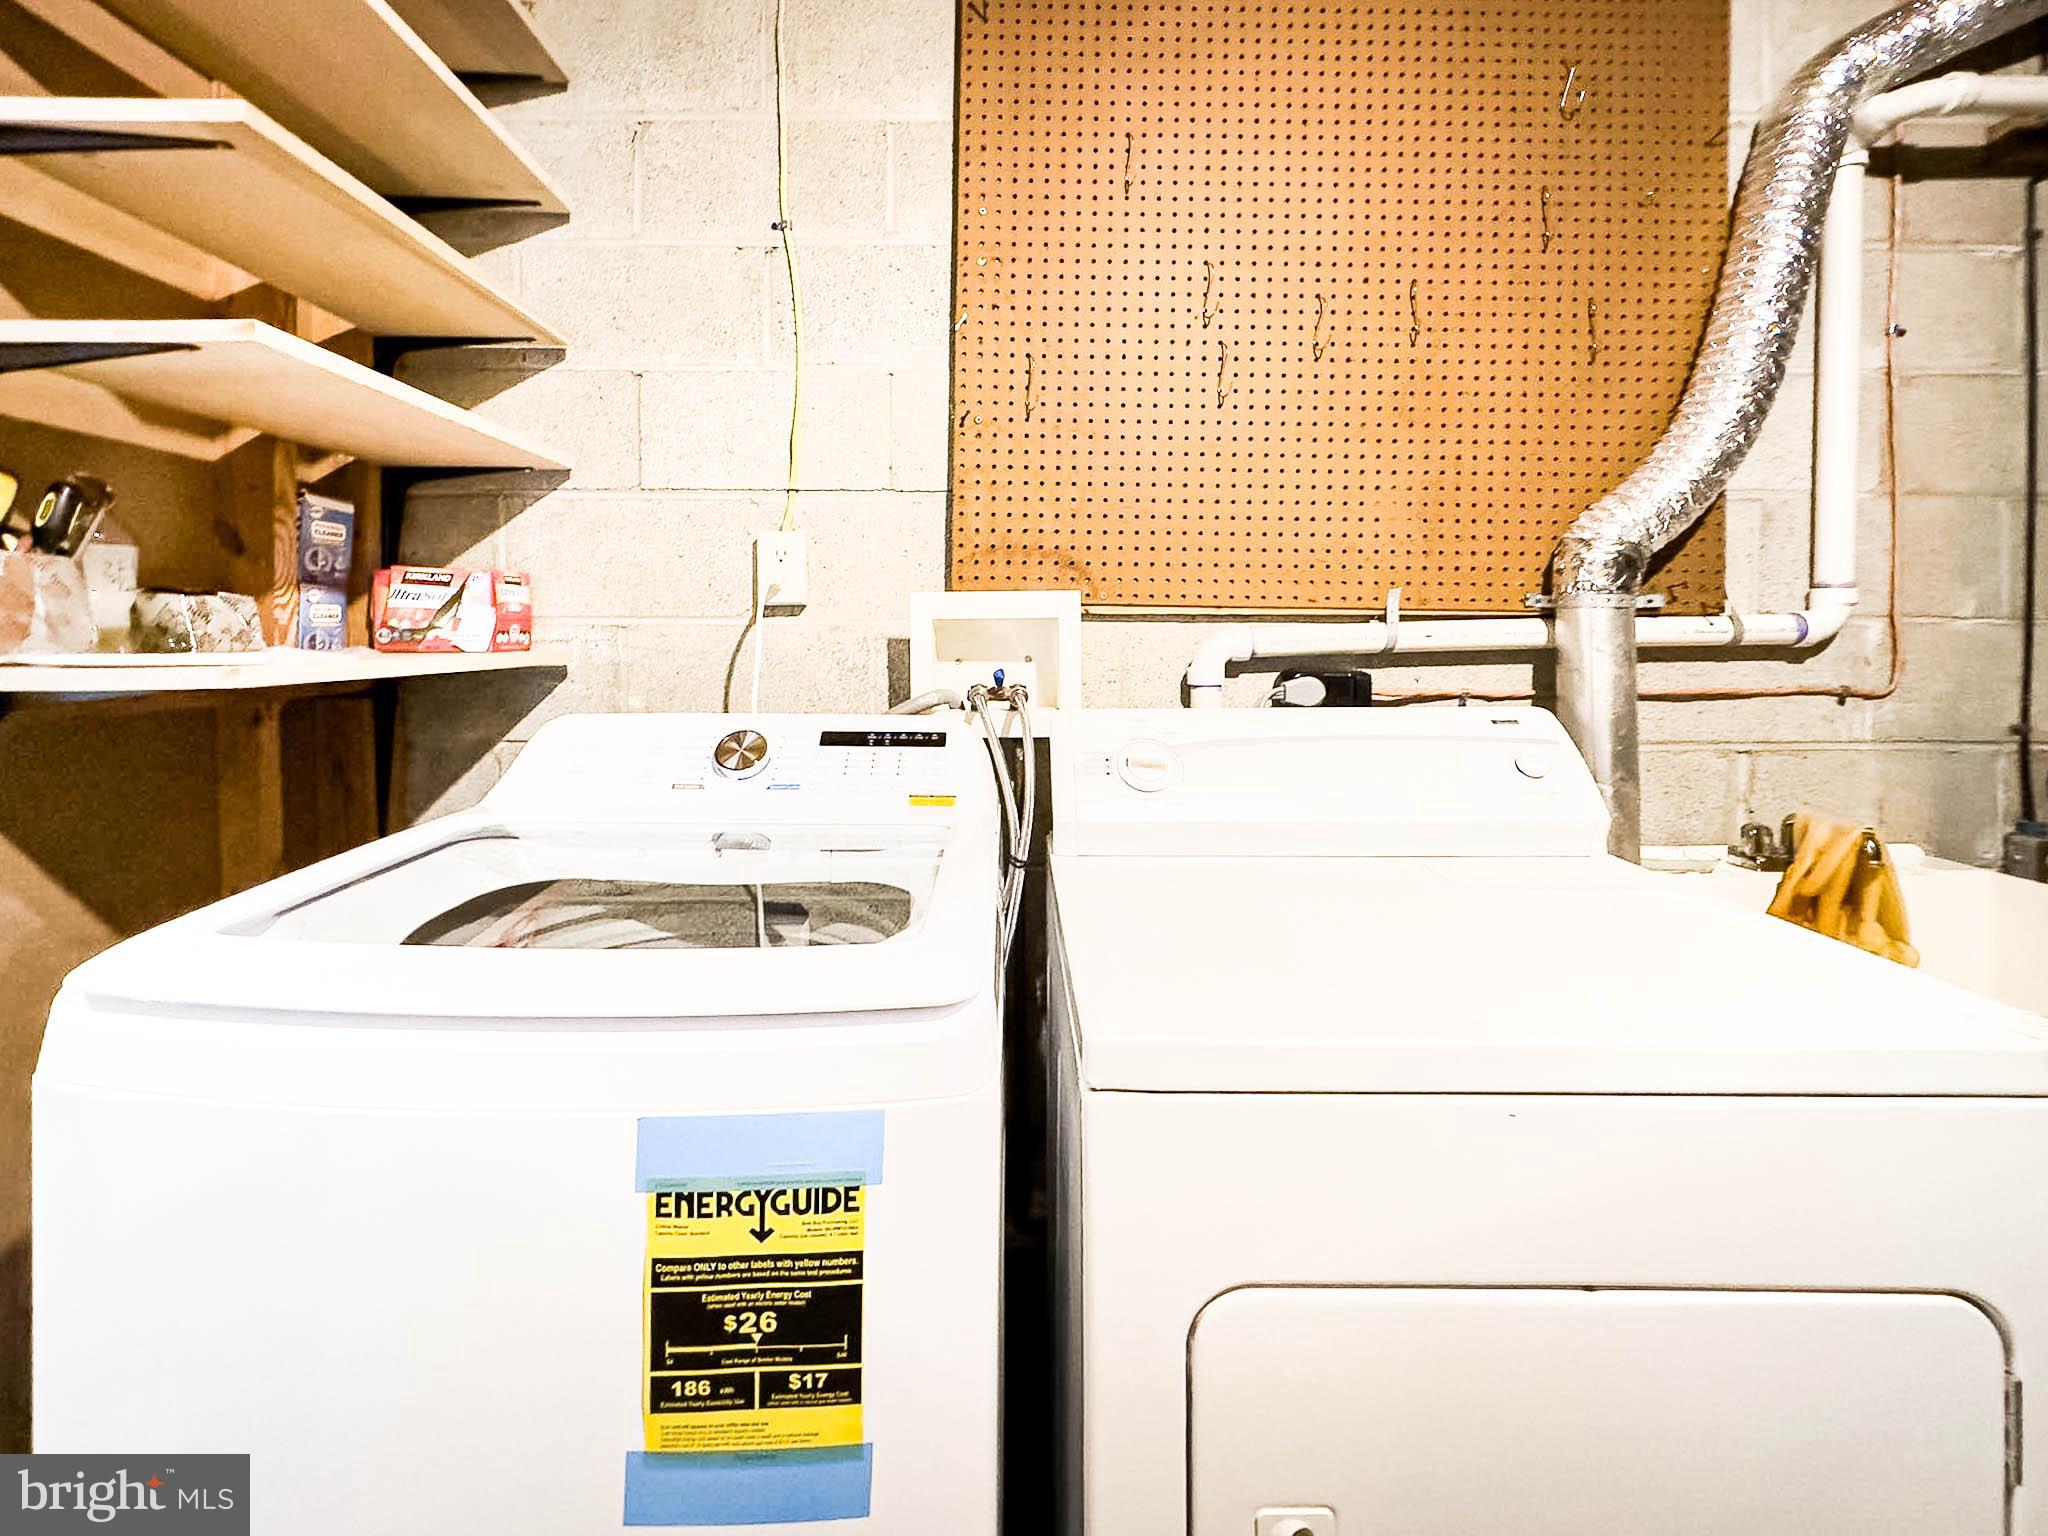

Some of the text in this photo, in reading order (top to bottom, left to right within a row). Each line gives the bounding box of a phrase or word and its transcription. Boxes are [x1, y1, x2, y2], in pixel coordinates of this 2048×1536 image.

[404, 571, 452, 583] KIRKLAND
[655, 1186, 861, 1219] ENERGYGUIDE
[655, 1264, 692, 1274] Compare
[693, 1262, 717, 1272] ONLY
[717, 1262, 727, 1271] to
[727, 1261, 749, 1270] other
[750, 1259, 775, 1269] labels
[776, 1258, 794, 1268] with
[794, 1258, 820, 1270] yellow
[701, 1289, 812, 1303] Estimated Yearly Energy Cost
[723, 1311, 778, 1334] $26
[670, 1380, 712, 1397] 186
[788, 1372, 829, 1391] $17
